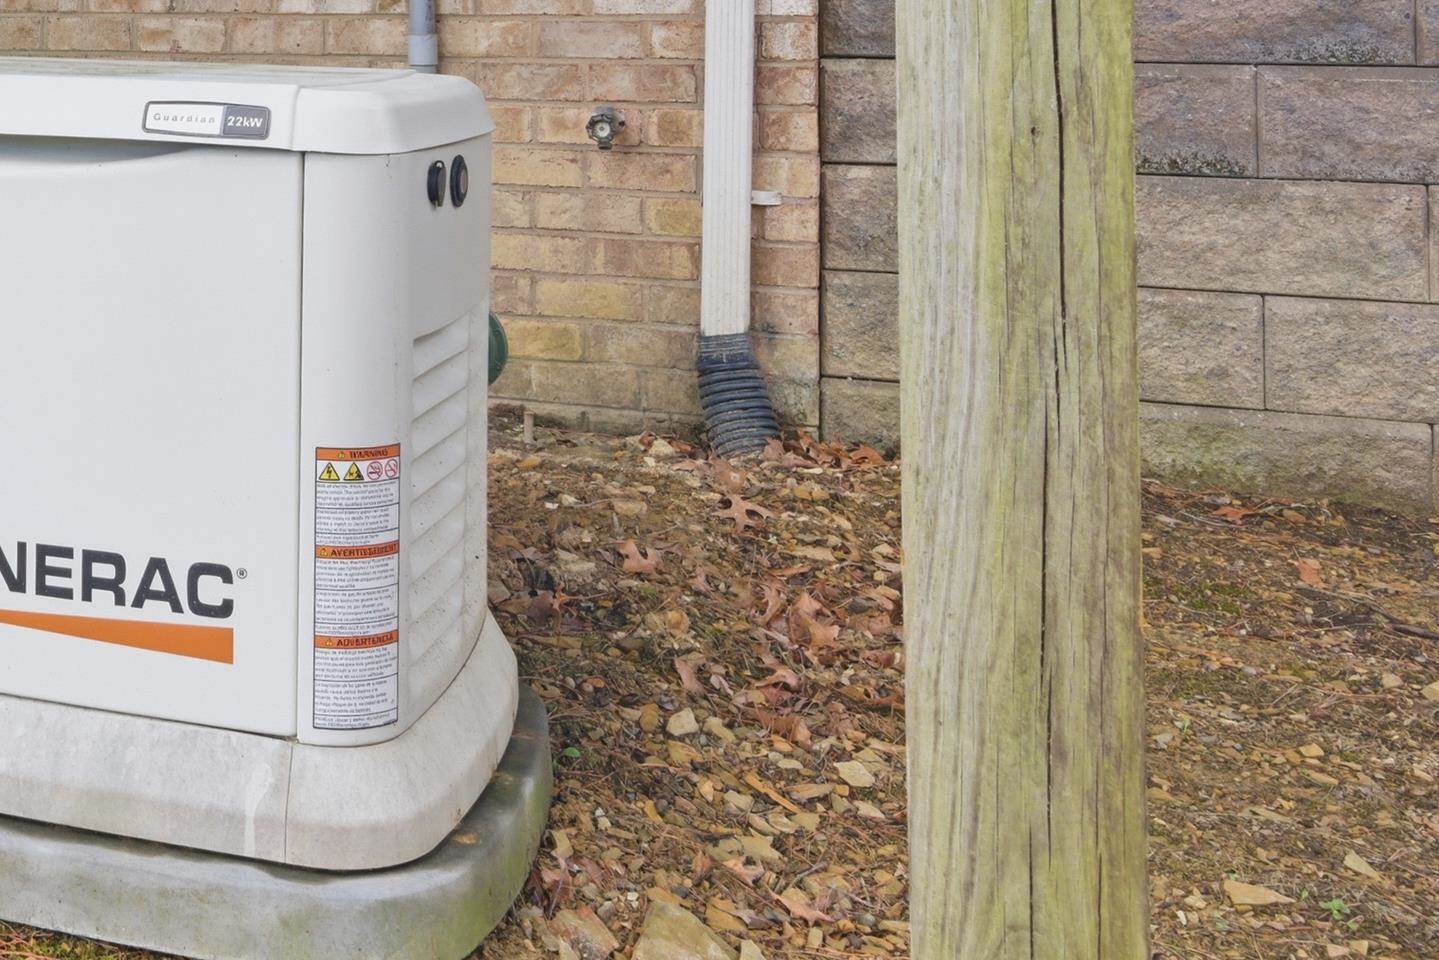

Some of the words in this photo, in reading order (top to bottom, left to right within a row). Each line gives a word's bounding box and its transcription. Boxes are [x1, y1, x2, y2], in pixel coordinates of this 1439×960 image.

[152, 112, 216, 124] Guardian
[226, 115, 264, 128] 22kW
[349, 448, 389, 459] WARNING
[336, 634, 394, 647] ADVERTENCIA
